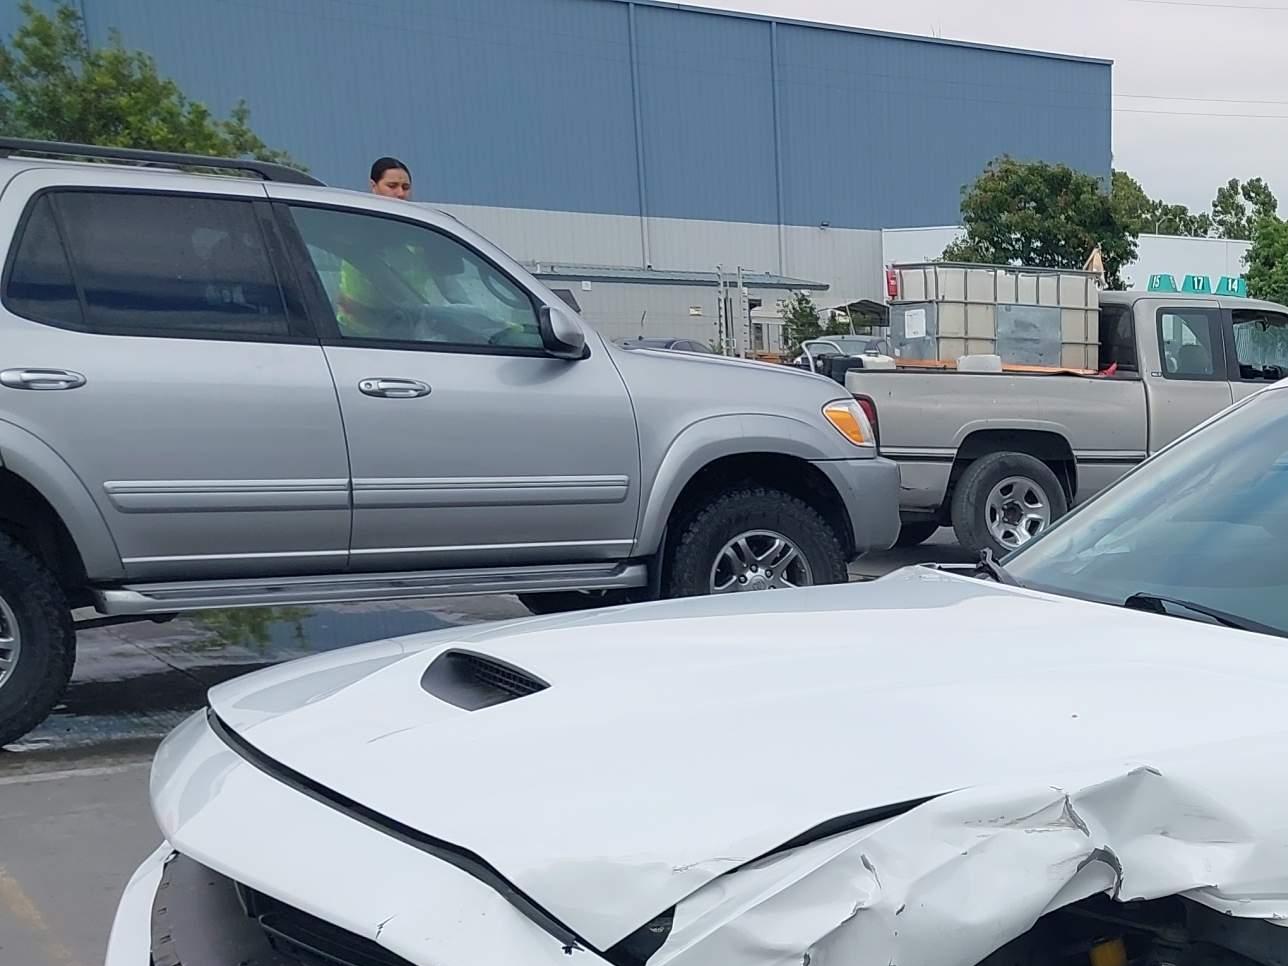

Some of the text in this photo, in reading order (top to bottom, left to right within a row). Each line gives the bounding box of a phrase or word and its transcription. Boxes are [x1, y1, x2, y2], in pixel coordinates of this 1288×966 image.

[1151, 275, 1160, 289] 15
[1193, 276, 1204, 291] 17
[1228, 278, 1238, 293] 14
